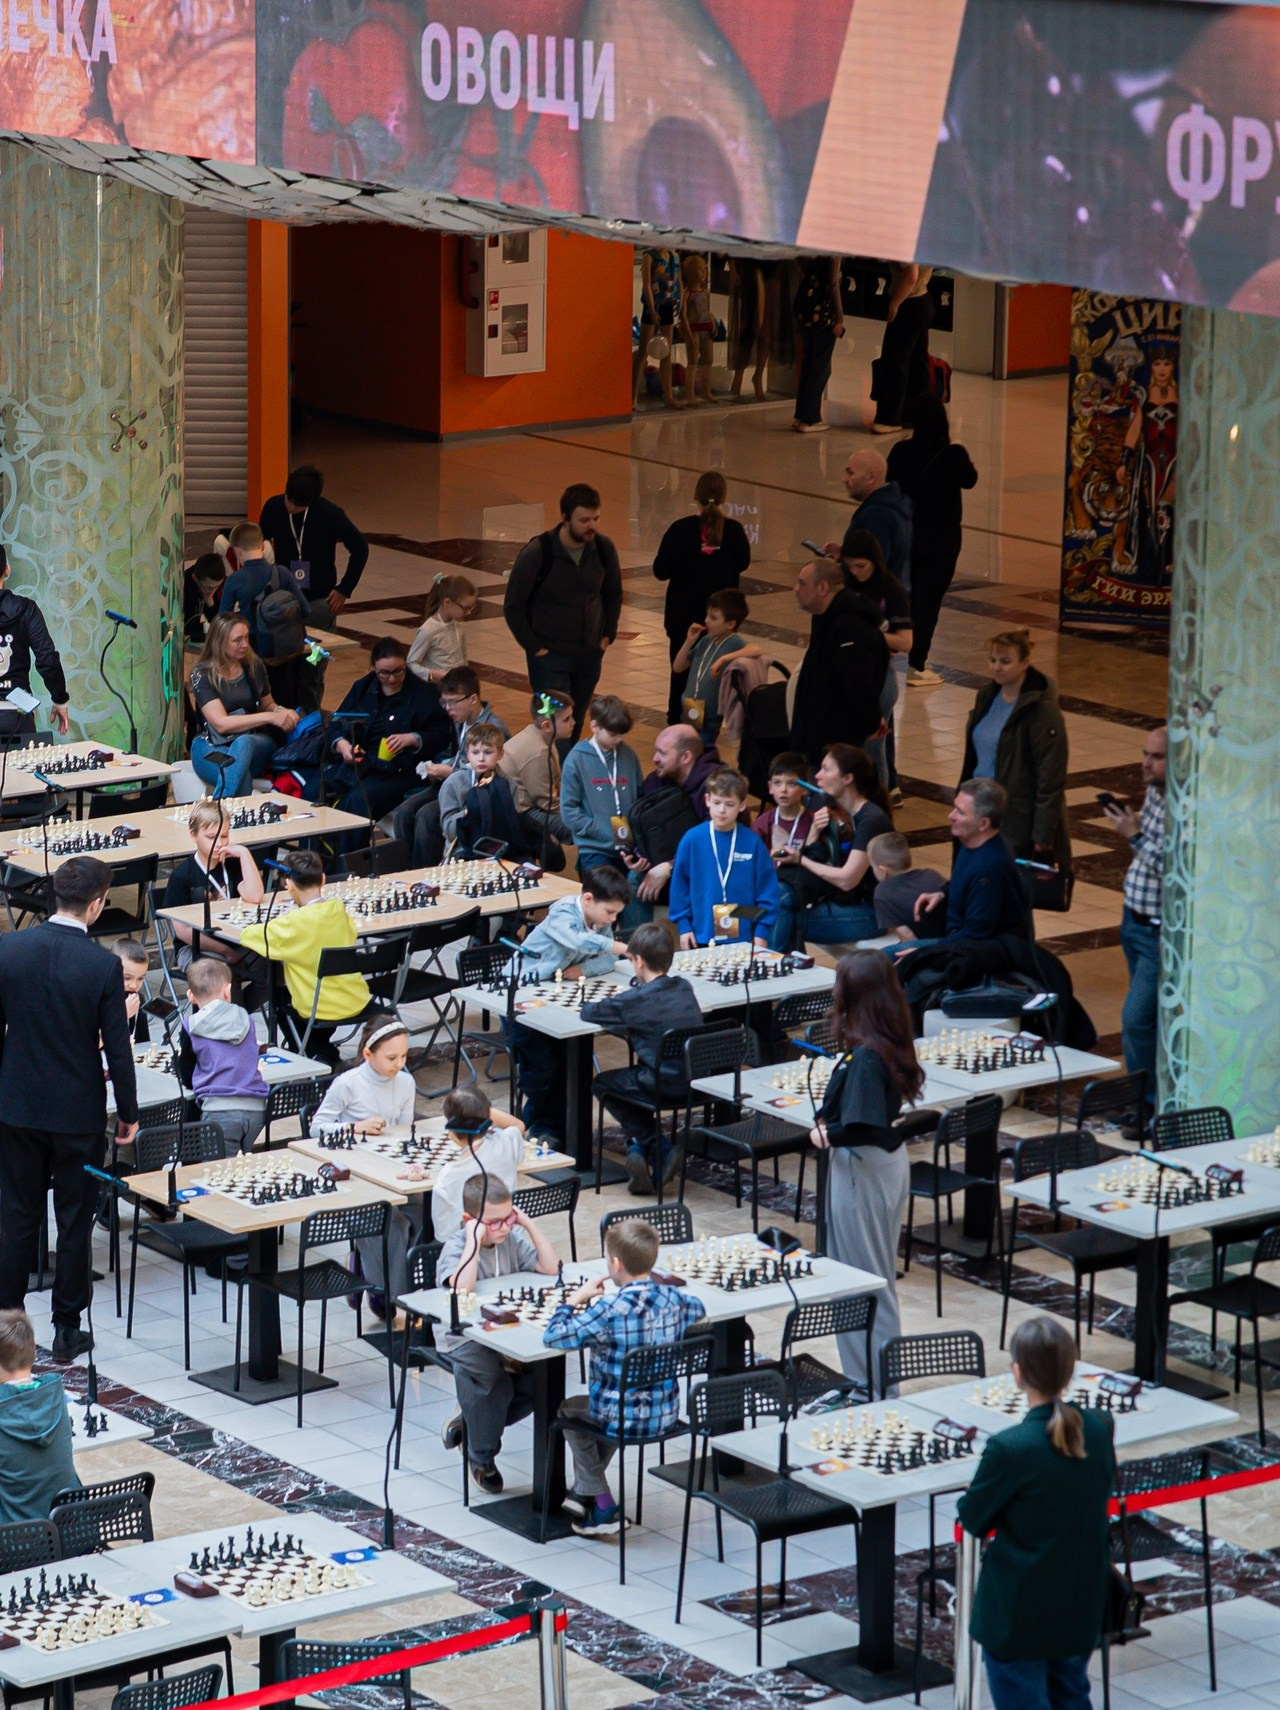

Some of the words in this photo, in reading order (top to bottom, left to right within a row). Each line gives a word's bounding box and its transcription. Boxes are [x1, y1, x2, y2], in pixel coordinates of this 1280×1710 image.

[421, 22, 615, 130] ОВОЩИ
[1166, 103, 1280, 215] ФР
[1091, 575, 1136, 602] ГИИ
